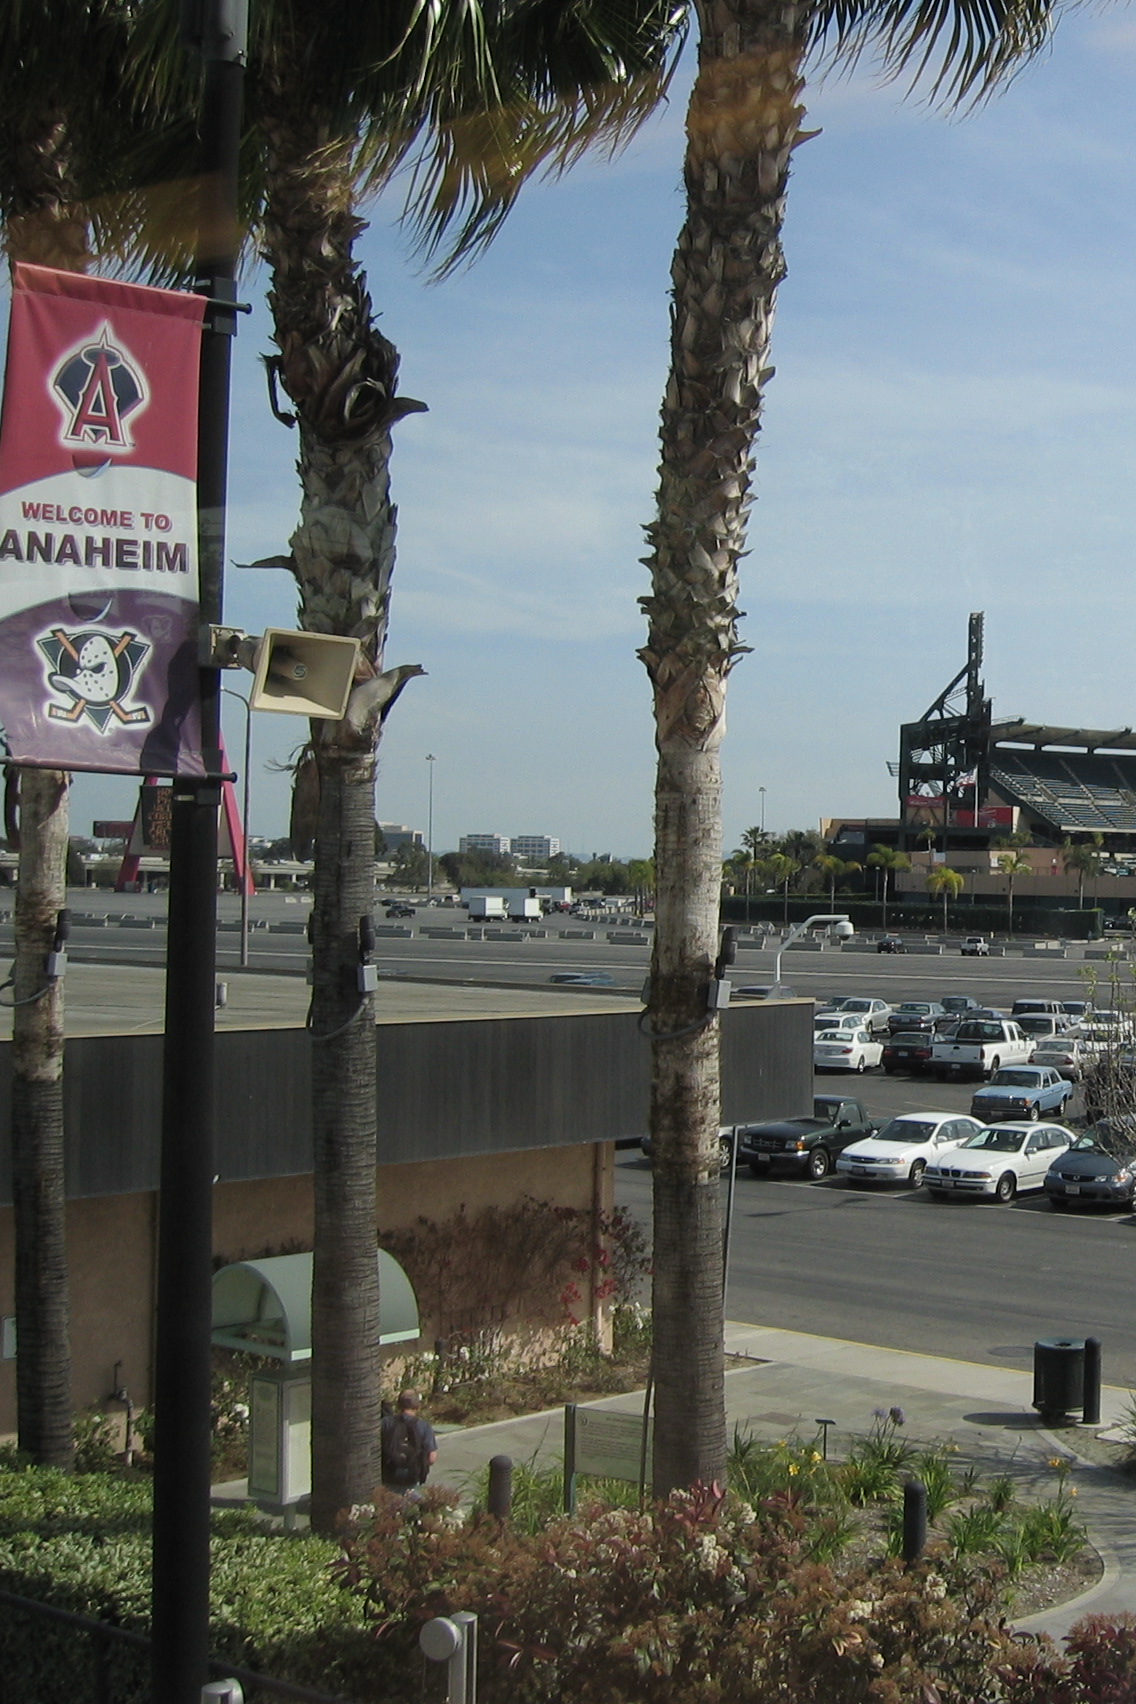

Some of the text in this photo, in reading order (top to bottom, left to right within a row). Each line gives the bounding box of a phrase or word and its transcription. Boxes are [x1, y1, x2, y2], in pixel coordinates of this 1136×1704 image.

[66, 340, 125, 445] A
[21, 501, 173, 533] WELCOME TO
[0, 529, 189, 574] ANAHEIM
